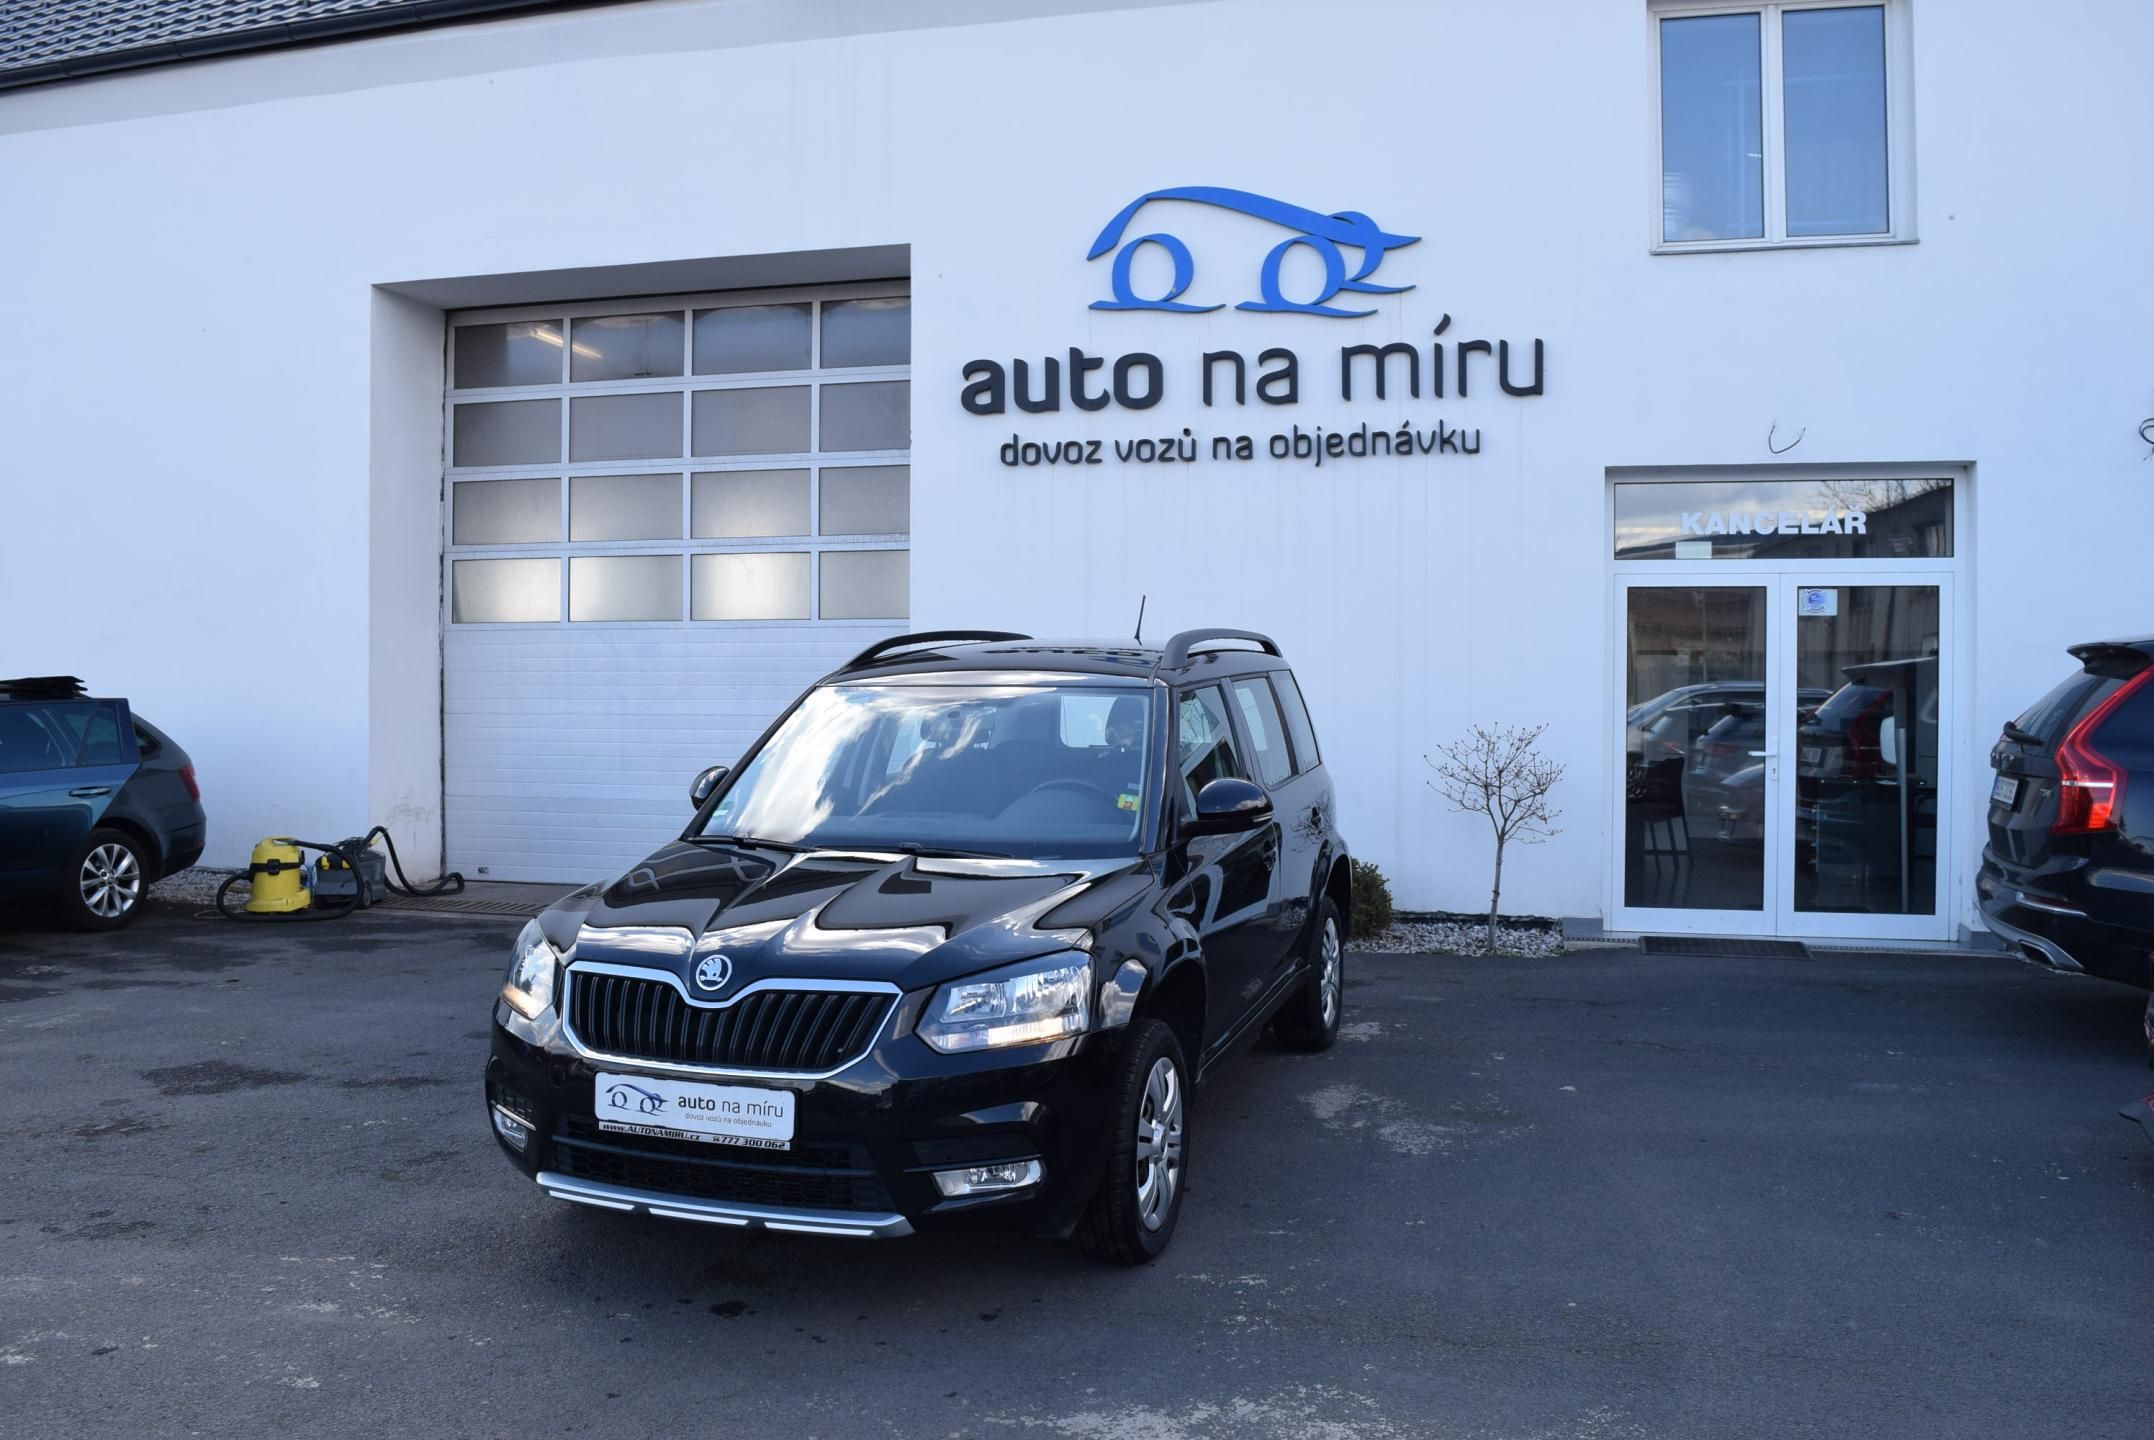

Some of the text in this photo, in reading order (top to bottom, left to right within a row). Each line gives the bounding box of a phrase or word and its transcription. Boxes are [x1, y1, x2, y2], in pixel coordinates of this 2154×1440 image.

[960, 313, 1544, 415] auto na míru
[1000, 419, 1481, 467] dovoz vozů na objednávku
[1681, 505, 1867, 534] KANCELÁŘ
[678, 1096, 784, 1118] auto na míru
